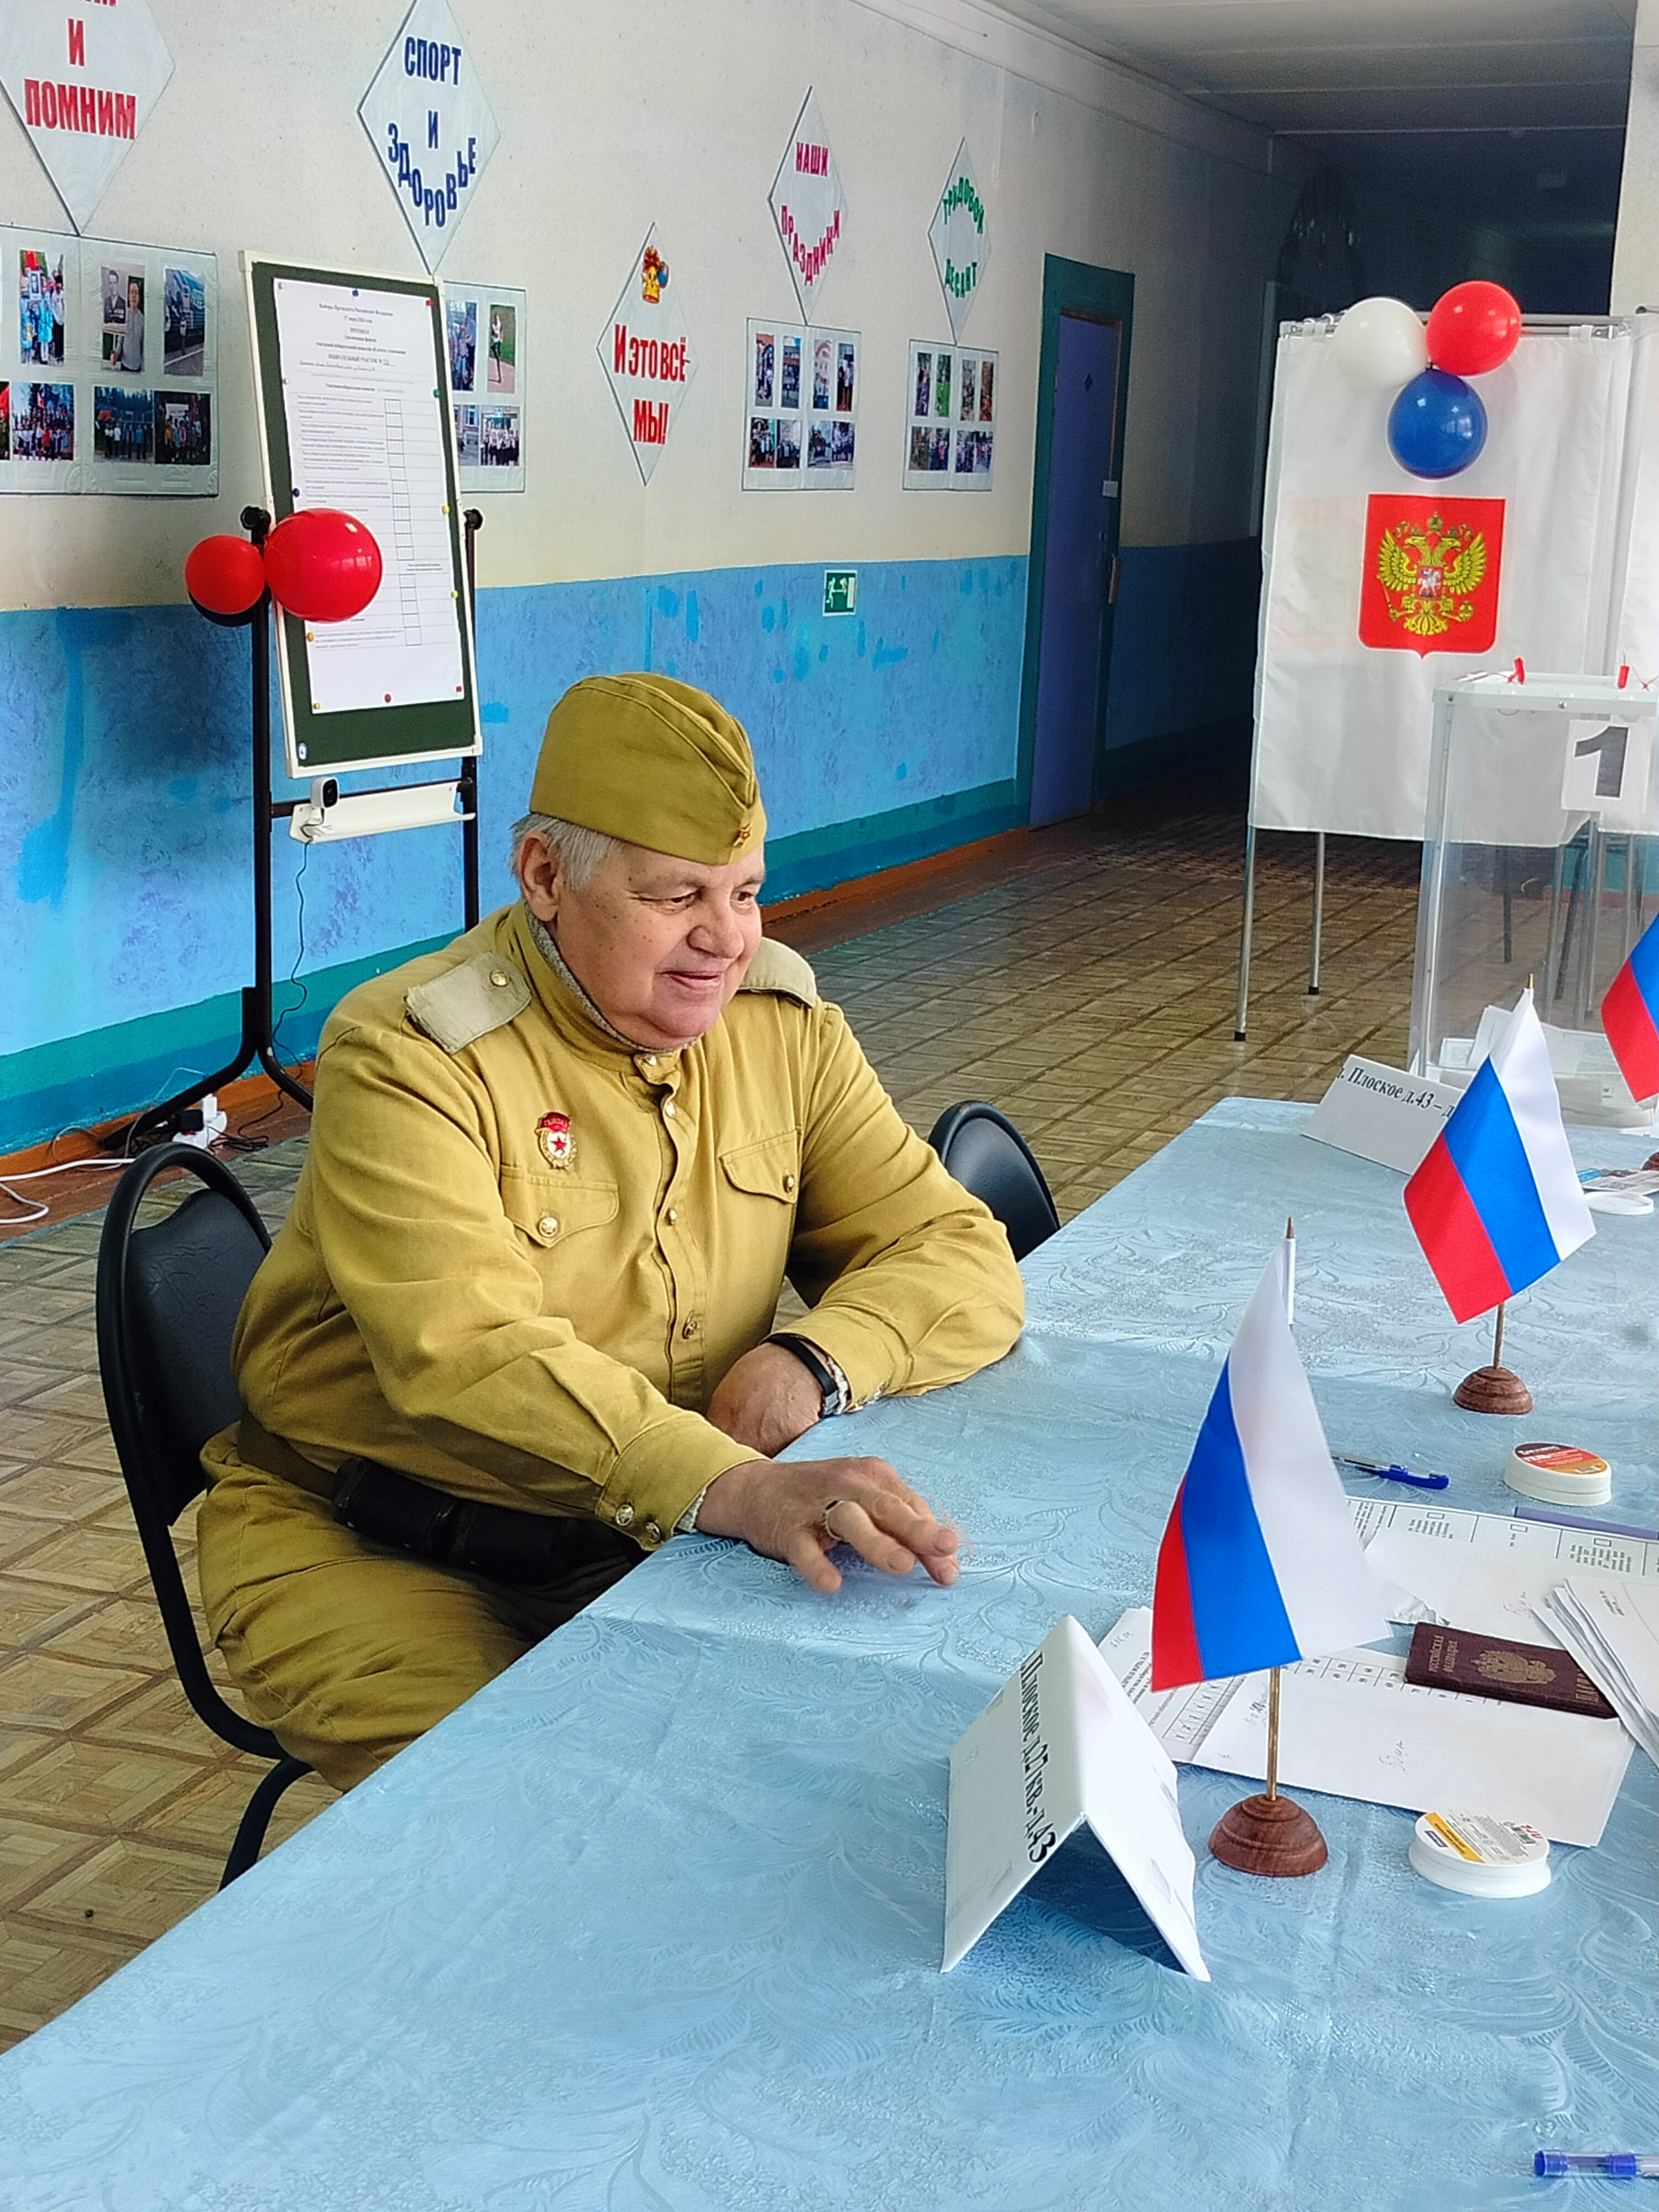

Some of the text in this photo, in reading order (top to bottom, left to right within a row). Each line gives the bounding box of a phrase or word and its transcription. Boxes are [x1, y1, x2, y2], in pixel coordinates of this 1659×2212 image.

[67, 18, 85, 66] И
[404, 36, 461, 85] СПОРТ
[24, 78, 137, 140] ПОМНИМ
[428, 110, 439, 149] И
[388, 122, 476, 228] ЗДОРОВЬЕ
[796, 142, 828, 177] НАШИ
[781, 205, 840, 286] ПРАЗДНИКИ
[943, 258, 977, 299] ДЕСАНТ
[614, 324, 690, 382] И ЭТО ВСЁ
[633, 398, 669, 445] МЫ!
[1574, 726, 1629, 799] 1
[1348, 1067, 1404, 1099] Плоское
[1402, 1090, 1434, 1109] д.43
